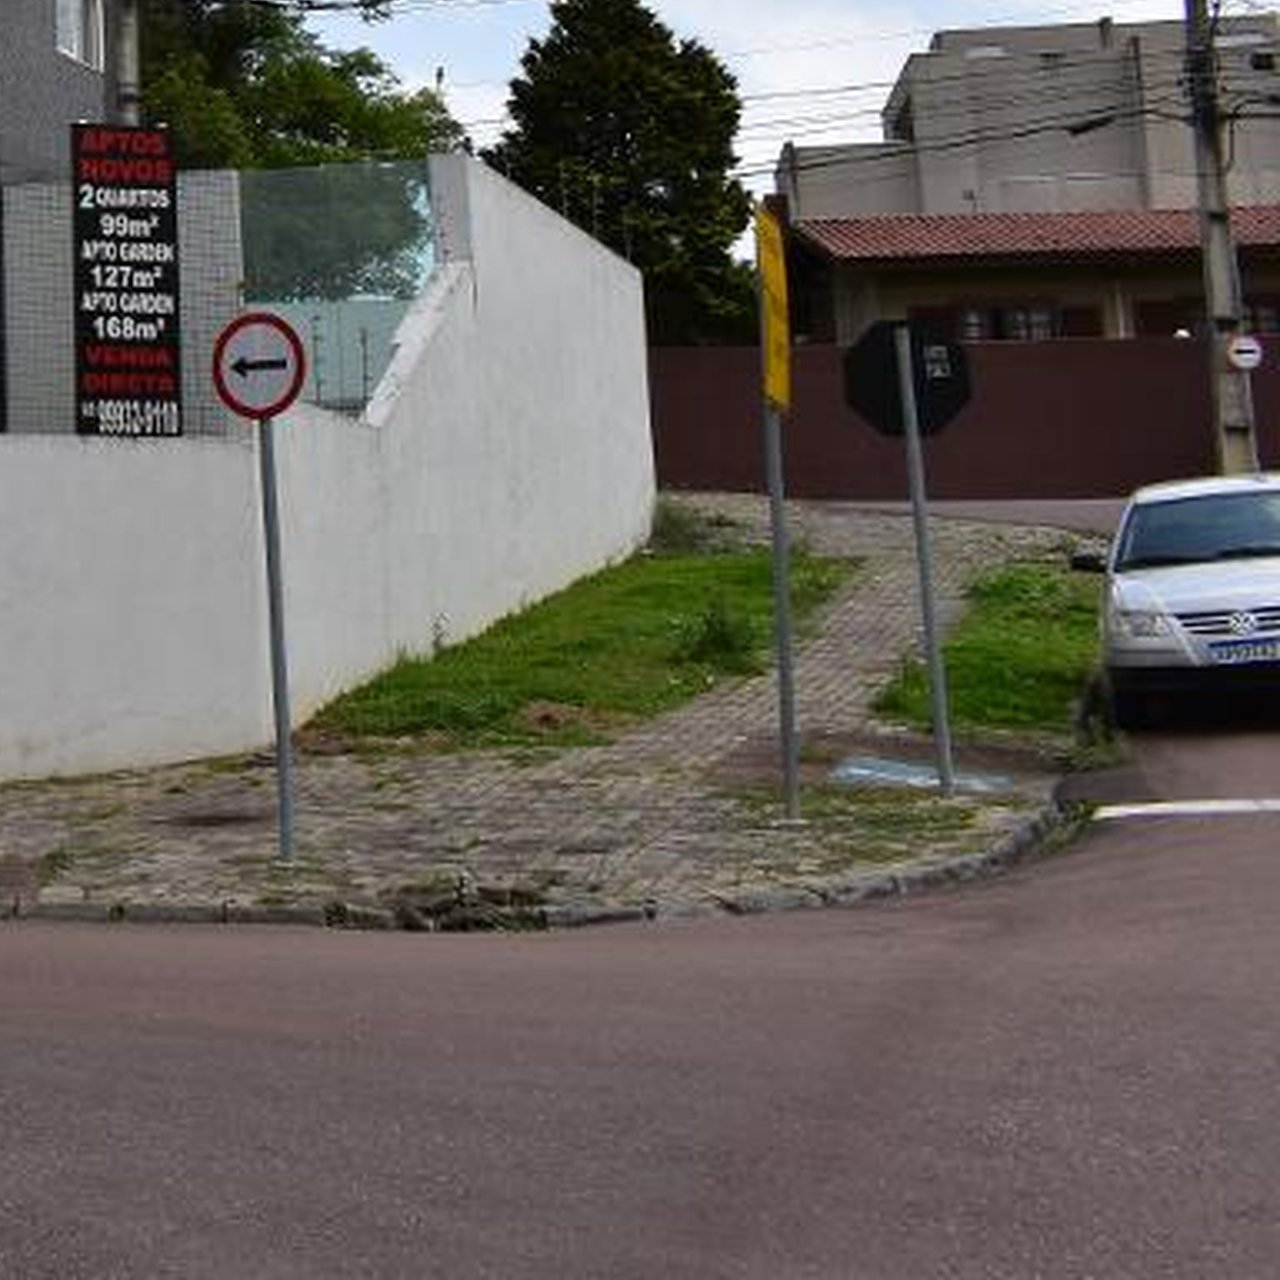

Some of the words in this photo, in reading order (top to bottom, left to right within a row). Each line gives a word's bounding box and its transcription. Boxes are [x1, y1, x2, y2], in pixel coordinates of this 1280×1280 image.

[79, 130, 165, 154] APTOS
[79, 159, 172, 181] NOVOS
[80, 183, 95, 208] 2
[96, 186, 170, 208] QUARTOS
[82, 240, 116, 261] APTO
[81, 291, 116, 312] APTO
